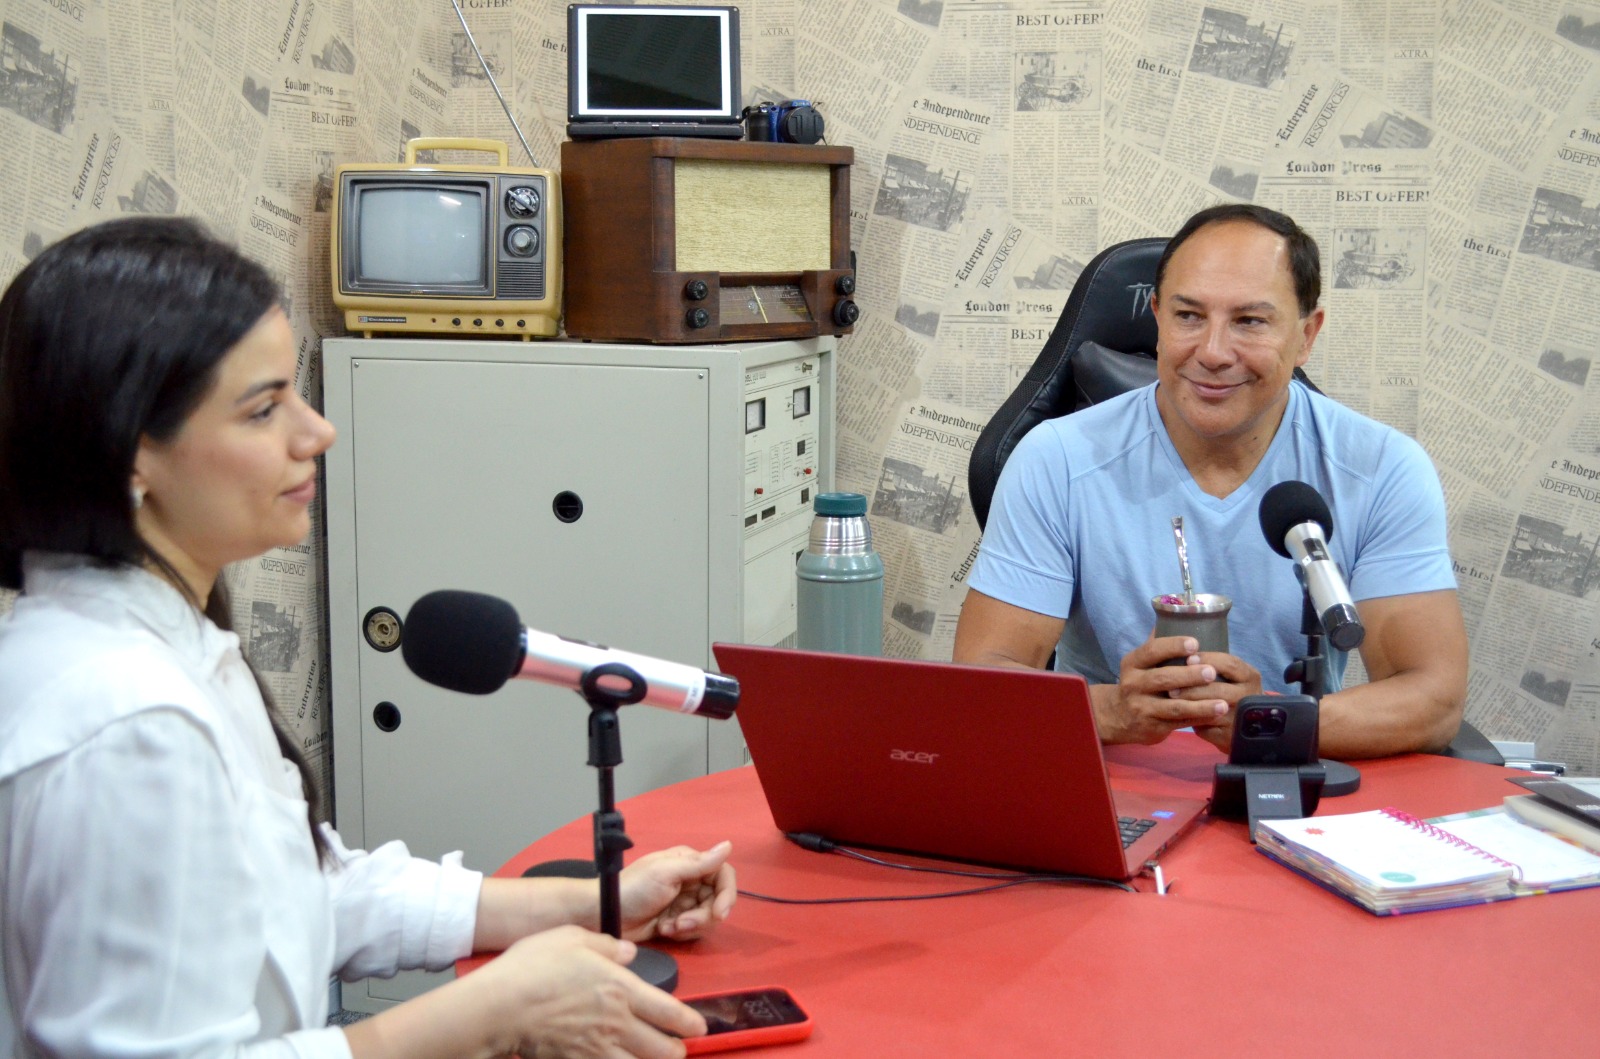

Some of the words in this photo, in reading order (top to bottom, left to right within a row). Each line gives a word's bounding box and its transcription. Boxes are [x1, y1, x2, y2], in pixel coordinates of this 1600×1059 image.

[1016, 15, 1051, 26] BEST
[1054, 13, 1104, 26] OFFER!
[542, 38, 557, 51] the
[1137, 58, 1156, 72] the
[1158, 63, 1182, 79] first
[285, 77, 311, 94] London
[311, 111, 329, 125] BEST
[921, 98, 992, 125] Independence
[1276, 83, 1319, 142] Enterprise
[1305, 82, 1350, 149] RESOURCES
[72, 133, 100, 201] Enterprise
[93, 132, 121, 210] RESOURCES
[1286, 160, 1335, 175] London
[1336, 191, 1372, 202] BEST
[1376, 190, 1430, 202] OFFER!
[261, 195, 302, 226] Independence
[955, 227, 994, 282] Enterprise
[981, 226, 1023, 289] RESOURCES
[1463, 237, 1484, 252] the
[1486, 243, 1513, 260] first
[965, 300, 1011, 315] London
[1011, 328, 1045, 340] BEST
[1452, 560, 1467, 575] he
[1469, 566, 1495, 582] first
[297, 659, 317, 719] Enterprise
[890, 749, 939, 764] acer
